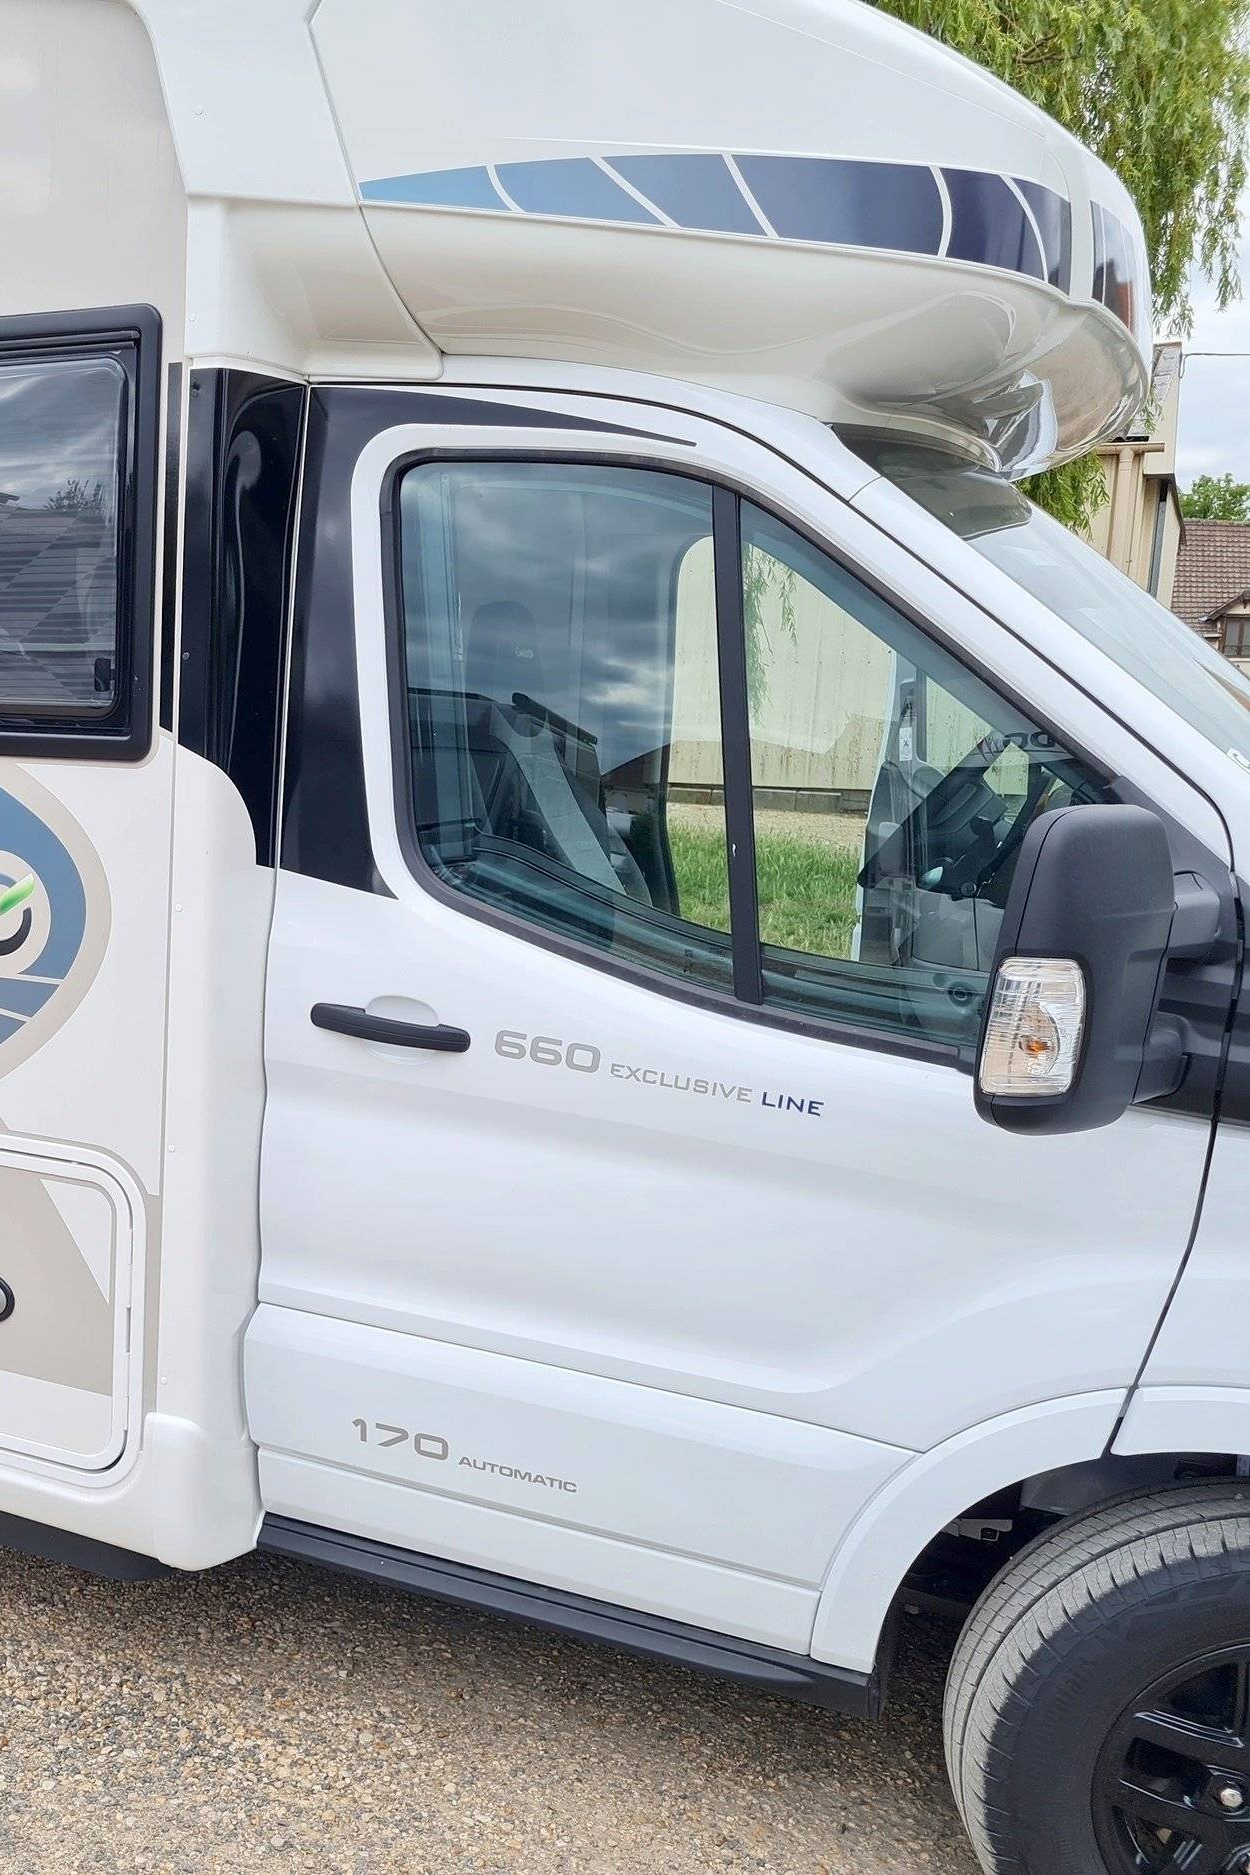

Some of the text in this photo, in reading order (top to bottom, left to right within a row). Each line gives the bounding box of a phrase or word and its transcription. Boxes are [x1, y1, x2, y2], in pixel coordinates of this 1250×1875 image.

[494, 1029, 824, 1116] 660 EXCLUSIVE LINE
[352, 1418, 577, 1493] 170 AUTOMATIC
